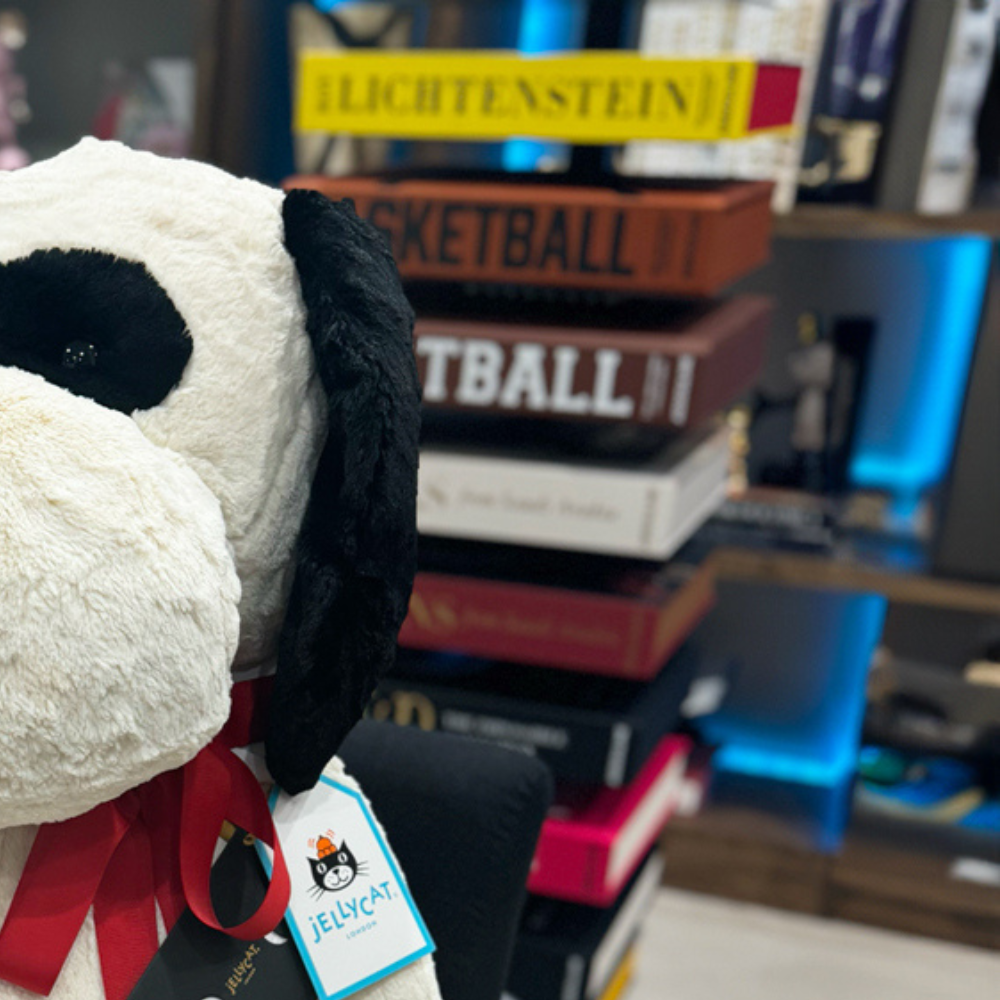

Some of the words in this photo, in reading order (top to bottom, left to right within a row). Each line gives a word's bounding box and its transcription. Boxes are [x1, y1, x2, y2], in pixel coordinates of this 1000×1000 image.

[337, 73, 695, 119] LICHTENSTEIN
[370, 200, 634, 276] SKETBALL
[417, 334, 634, 418] TBALL
